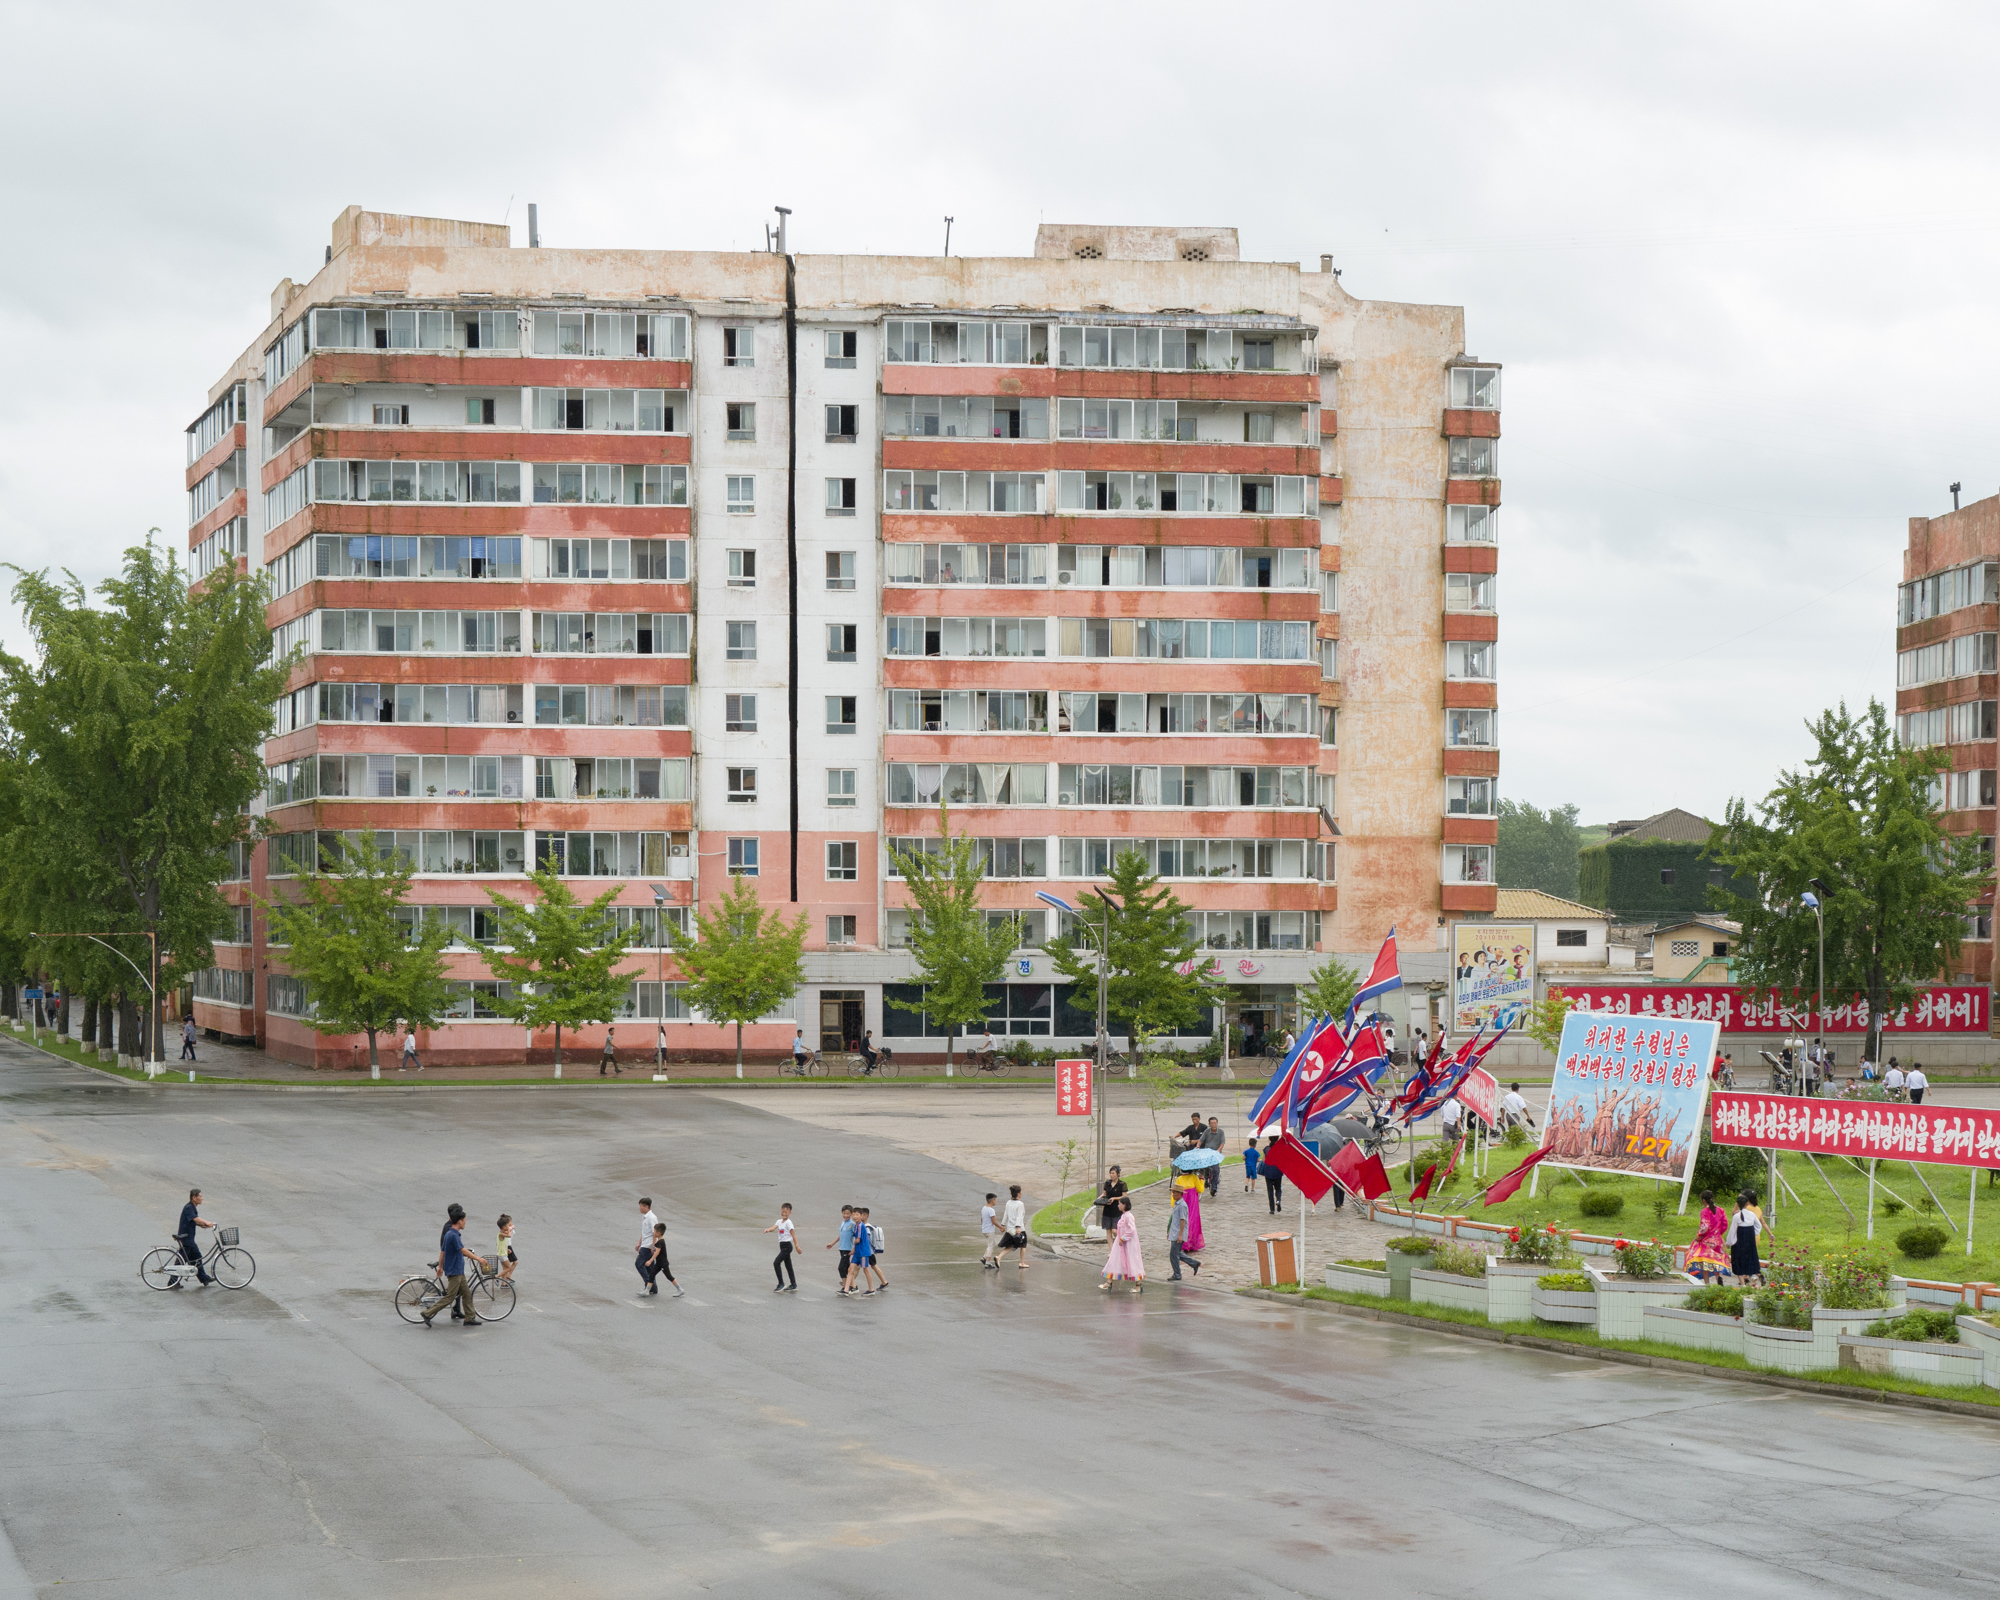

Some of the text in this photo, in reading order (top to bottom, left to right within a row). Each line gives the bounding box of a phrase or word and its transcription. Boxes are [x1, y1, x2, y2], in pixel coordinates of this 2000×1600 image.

[1019, 961, 1030, 973] 점
[1915, 993, 1980, 1028] 위하여!
[1584, 1025, 1691, 1058] 위대한 수령님은
[1566, 1053, 1698, 1089] 백전백승의 강철의 령장
[1715, 1100, 1751, 1137] 위대한
[1751, 1100, 1811, 1145] 김정은동지
[1811, 1107, 1841, 1147] 따라
[1930, 1116, 1975, 1158] 끝까지
[1625, 1134, 1673, 1159] 7.27
